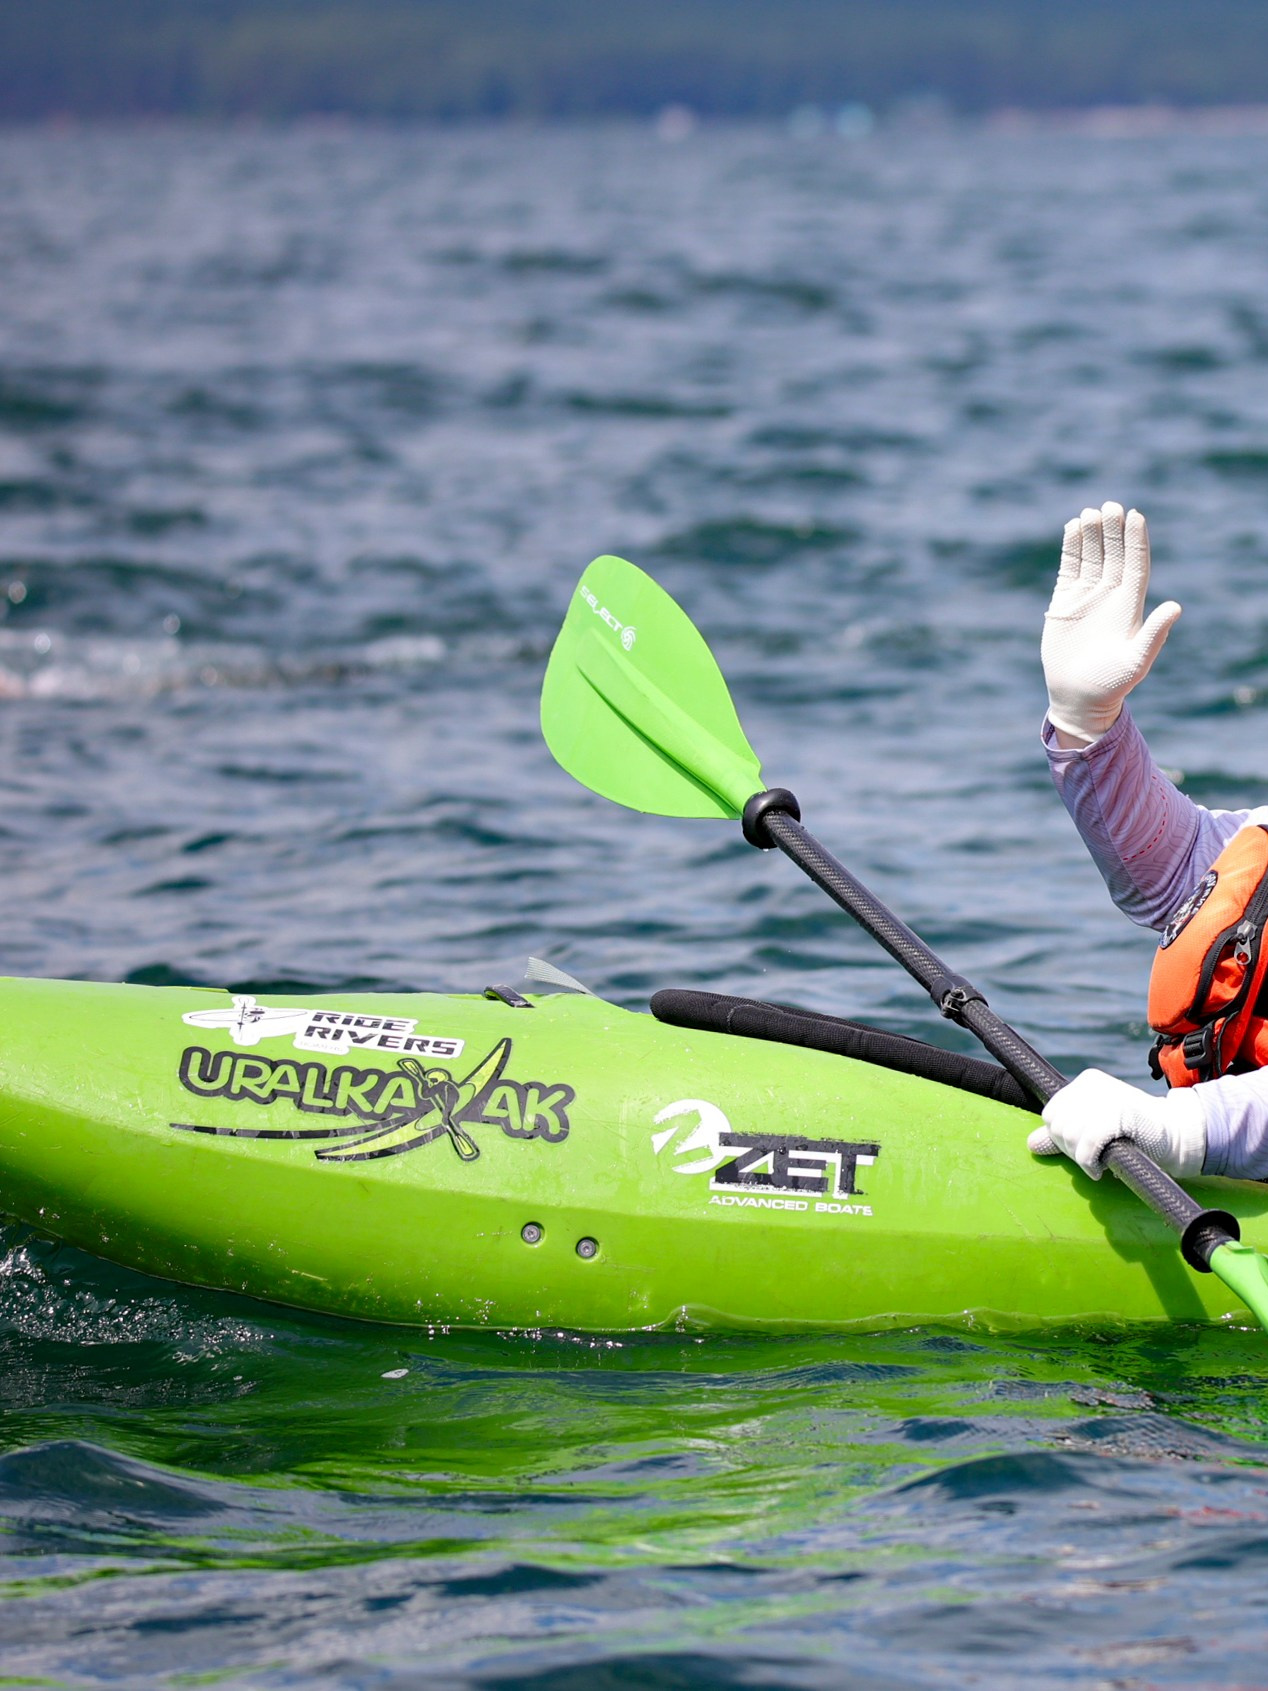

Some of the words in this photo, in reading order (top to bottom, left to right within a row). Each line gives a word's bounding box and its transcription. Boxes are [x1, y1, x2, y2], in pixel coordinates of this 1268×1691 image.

[580, 585, 623, 632] SELECT
[312, 1012, 410, 1032] RIDE
[304, 1025, 457, 1055] RIVERS
[709, 1131, 881, 1200] ZET
[708, 1195, 808, 1211] ADVANCED
[815, 1203, 873, 1216] BOATS
